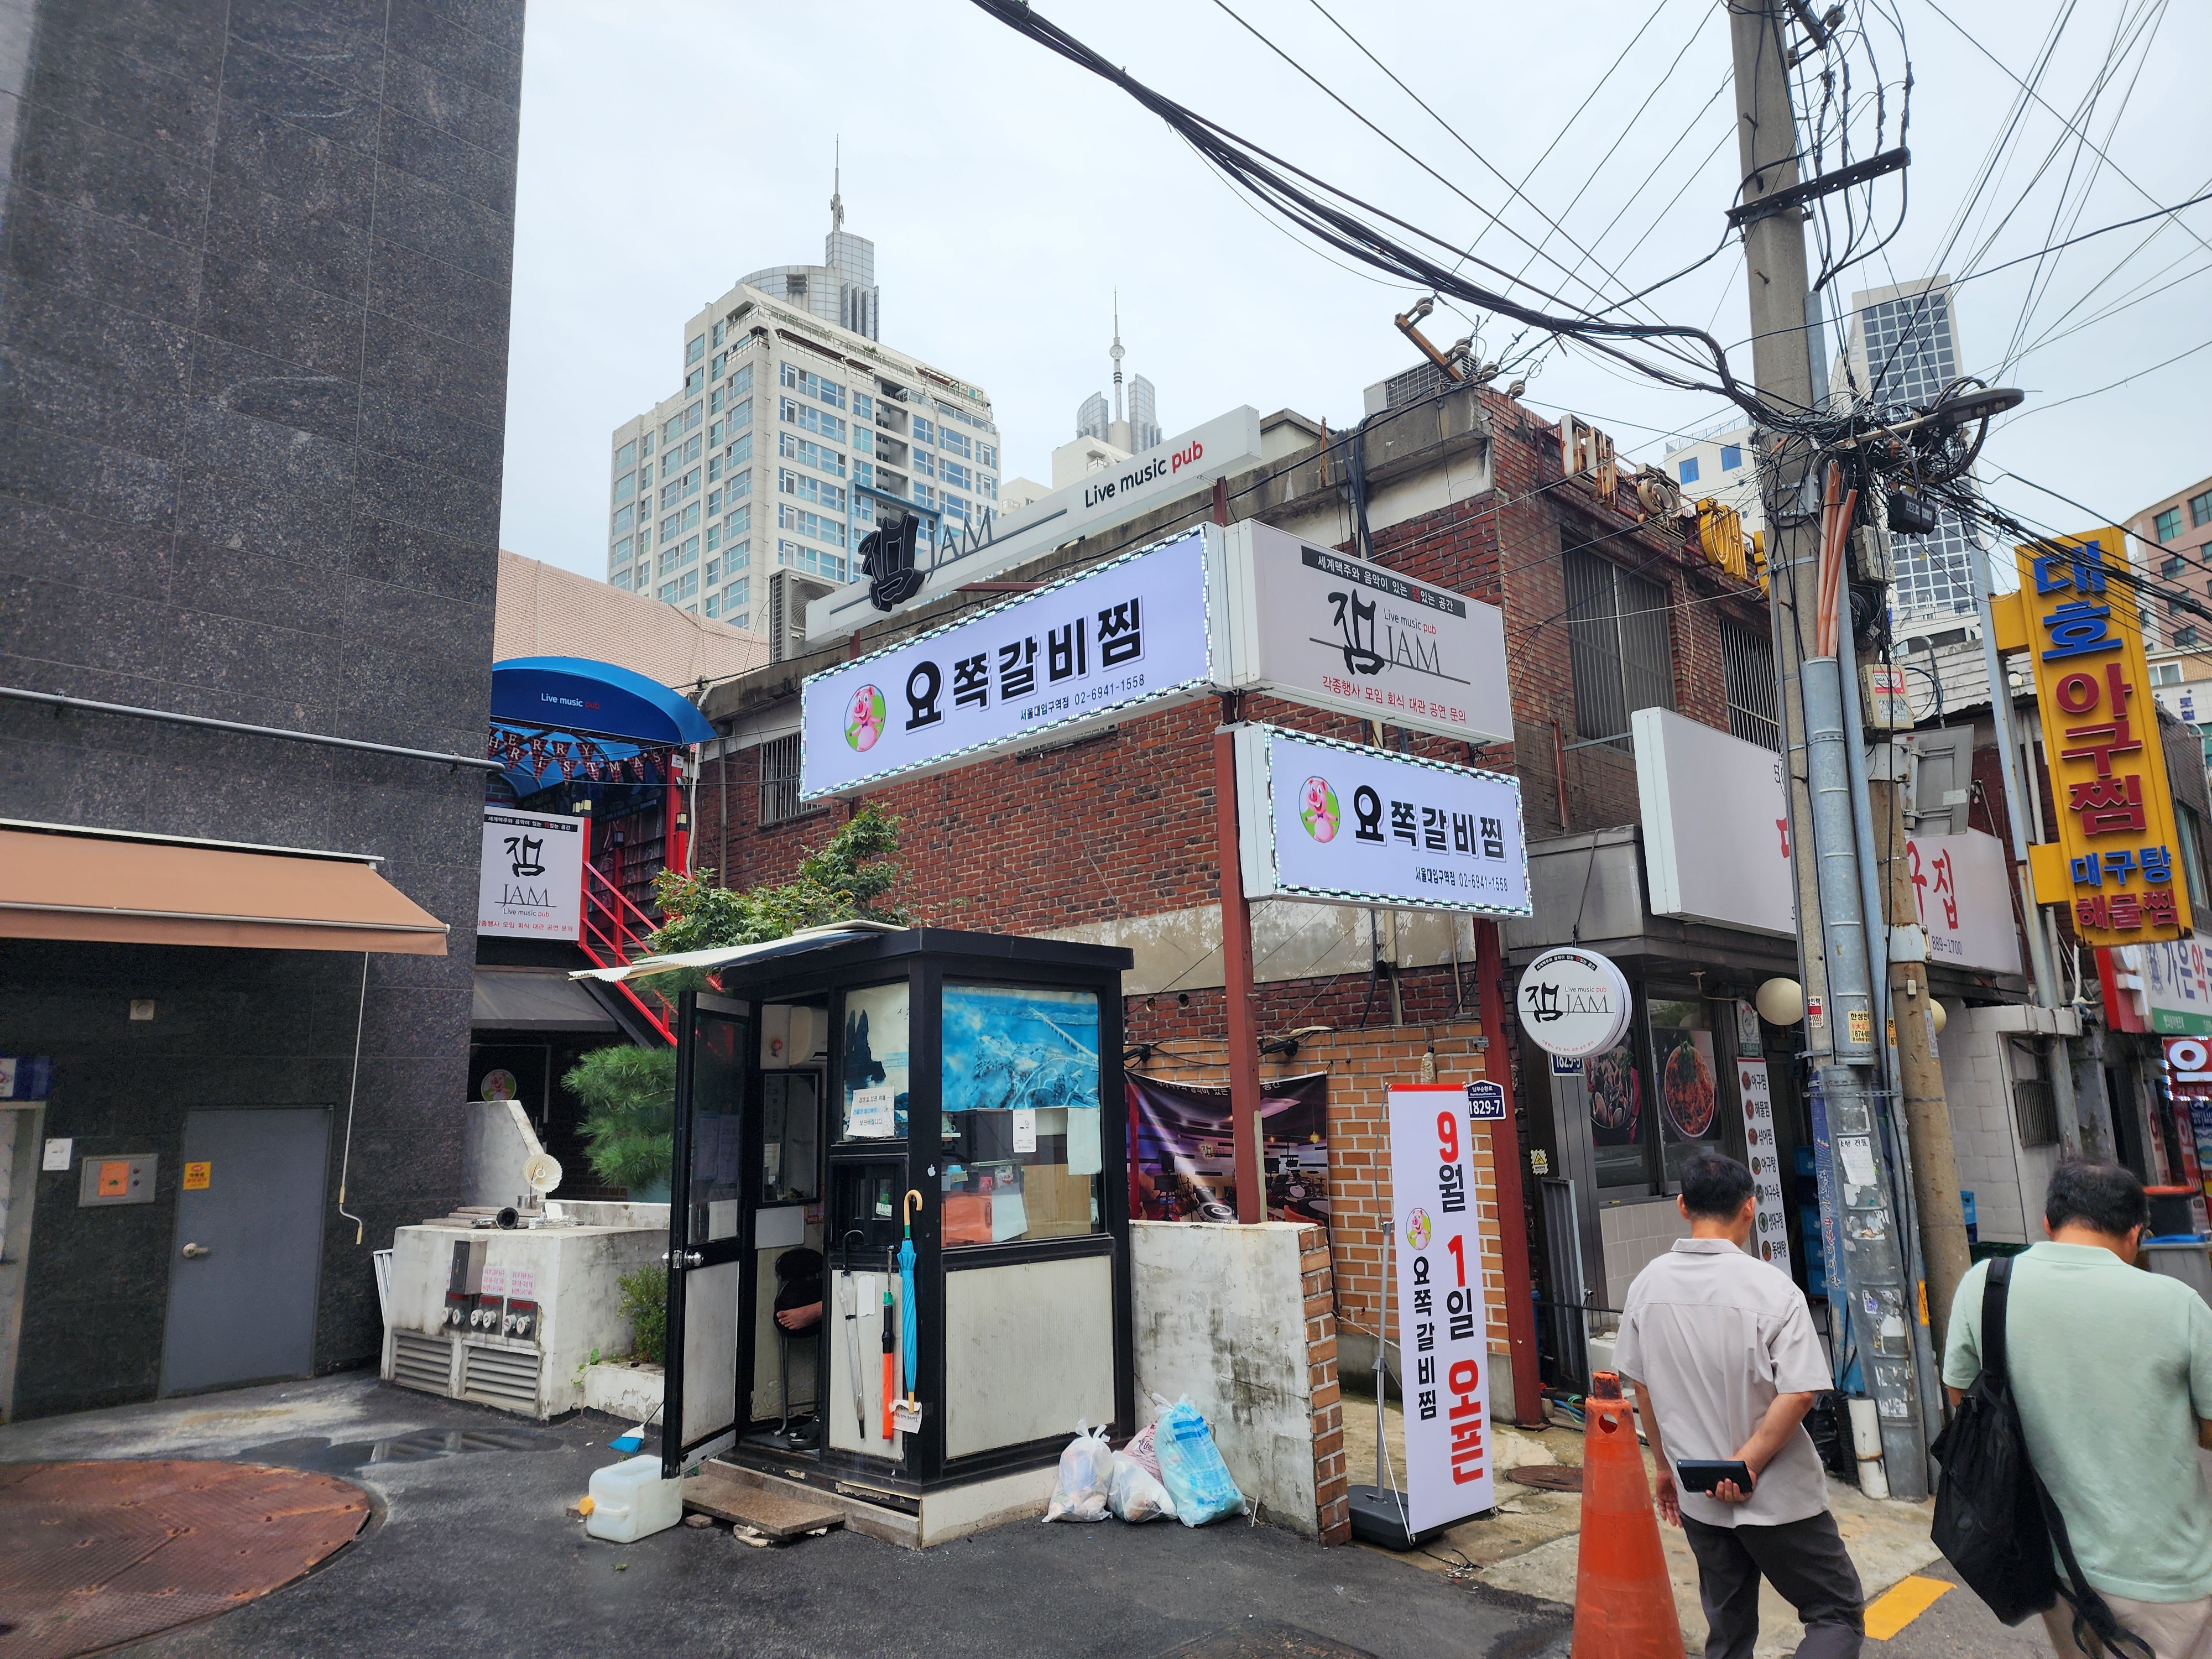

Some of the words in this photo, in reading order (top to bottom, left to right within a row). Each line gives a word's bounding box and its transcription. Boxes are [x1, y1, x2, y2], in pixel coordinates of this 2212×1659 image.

[1085, 484, 1115, 508] Live
[1120, 457, 1167, 491] music
[1171, 440, 1203, 474] pub
[926, 505, 995, 583] JAM
[1318, 555, 1360, 581] 세계맥주와
[1364, 571, 1389, 591] 음악이
[1392, 581, 1408, 597] 있는
[1411, 586, 1435, 606] 잼있는
[1439, 597, 1454, 612] 공간
[1384, 608, 1399, 623] Live
[1401, 617, 1422, 631] music
[1423, 622, 1437, 635] pub
[906, 597, 1141, 731] 요쪽갈비찜
[1385, 624, 1443, 672] JAM
[541, 693, 558, 703] Live
[560, 698, 583, 707] music
[585, 701, 601, 709] pub
[1020, 696, 1070, 721] 서울대입구역점
[1074, 674, 1145, 706] 02-6941-1558
[1322, 675, 1360, 699] 각종행사
[1365, 686, 1383, 703] 모임
[1387, 692, 1405, 709] 회식
[1409, 698, 1426, 714] 대관
[1430, 703, 1446, 719] 공연
[1450, 708, 1466, 724] 문의
[2032, 540, 2146, 836] 대호아구찜
[508, 734, 591, 755] ERRY
[1354, 785, 1505, 859] 요쪽갈비찜
[1416, 867, 1455, 886] 서울대입구역점
[1459, 873, 1509, 892] 02-6941-1558
[2070, 845, 2172, 886] 대구탕
[500, 884, 549, 909] JAM
[2076, 889, 2179, 930] 해물찜
[1932, 935, 1963, 956] 889-1700
[1564, 994, 1609, 1018] JAM
[1751, 1074, 1767, 1091] 아구찜
[1469, 1099, 1500, 1115] 1829-7
[1754, 1101, 1770, 1118] 해물찜
[1758, 1129, 1773, 1145] 섞어찜
[1437, 1111, 1466, 1213] 9월
[1761, 1156, 1776, 1173] 아구탕
[1765, 1183, 1781, 1202] 아구수육
[1768, 1212, 1784, 1230] 생대구탕
[1772, 1240, 1787, 1260] 동태탕
[1447, 1234, 1474, 1341] 1일
[1413, 1256, 1437, 1421] 요쪽갈비찜
[1448, 1359, 1484, 1485] 오픈
